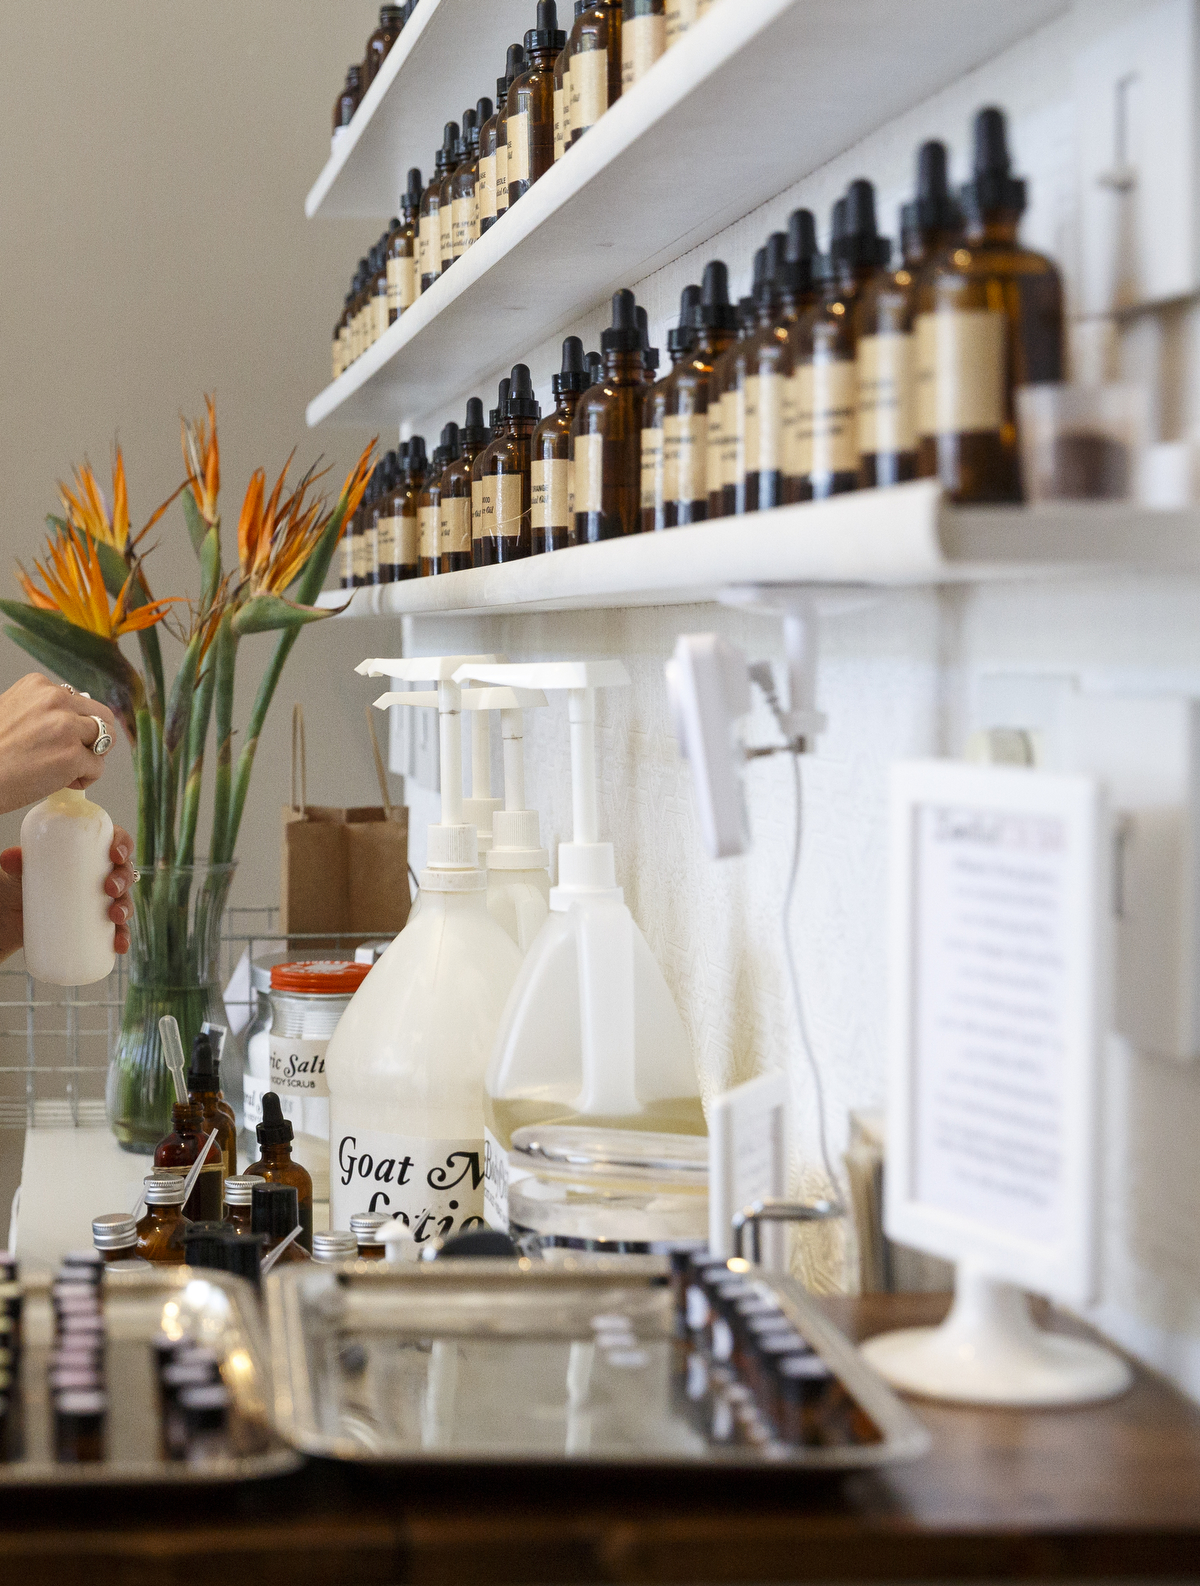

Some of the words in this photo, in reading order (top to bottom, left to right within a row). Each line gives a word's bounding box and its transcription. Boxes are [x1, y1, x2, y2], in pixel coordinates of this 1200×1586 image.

[283, 1053, 325, 1078] Salt
[287, 1078, 316, 1089] SCRUB
[338, 1135, 415, 1186] Goat
